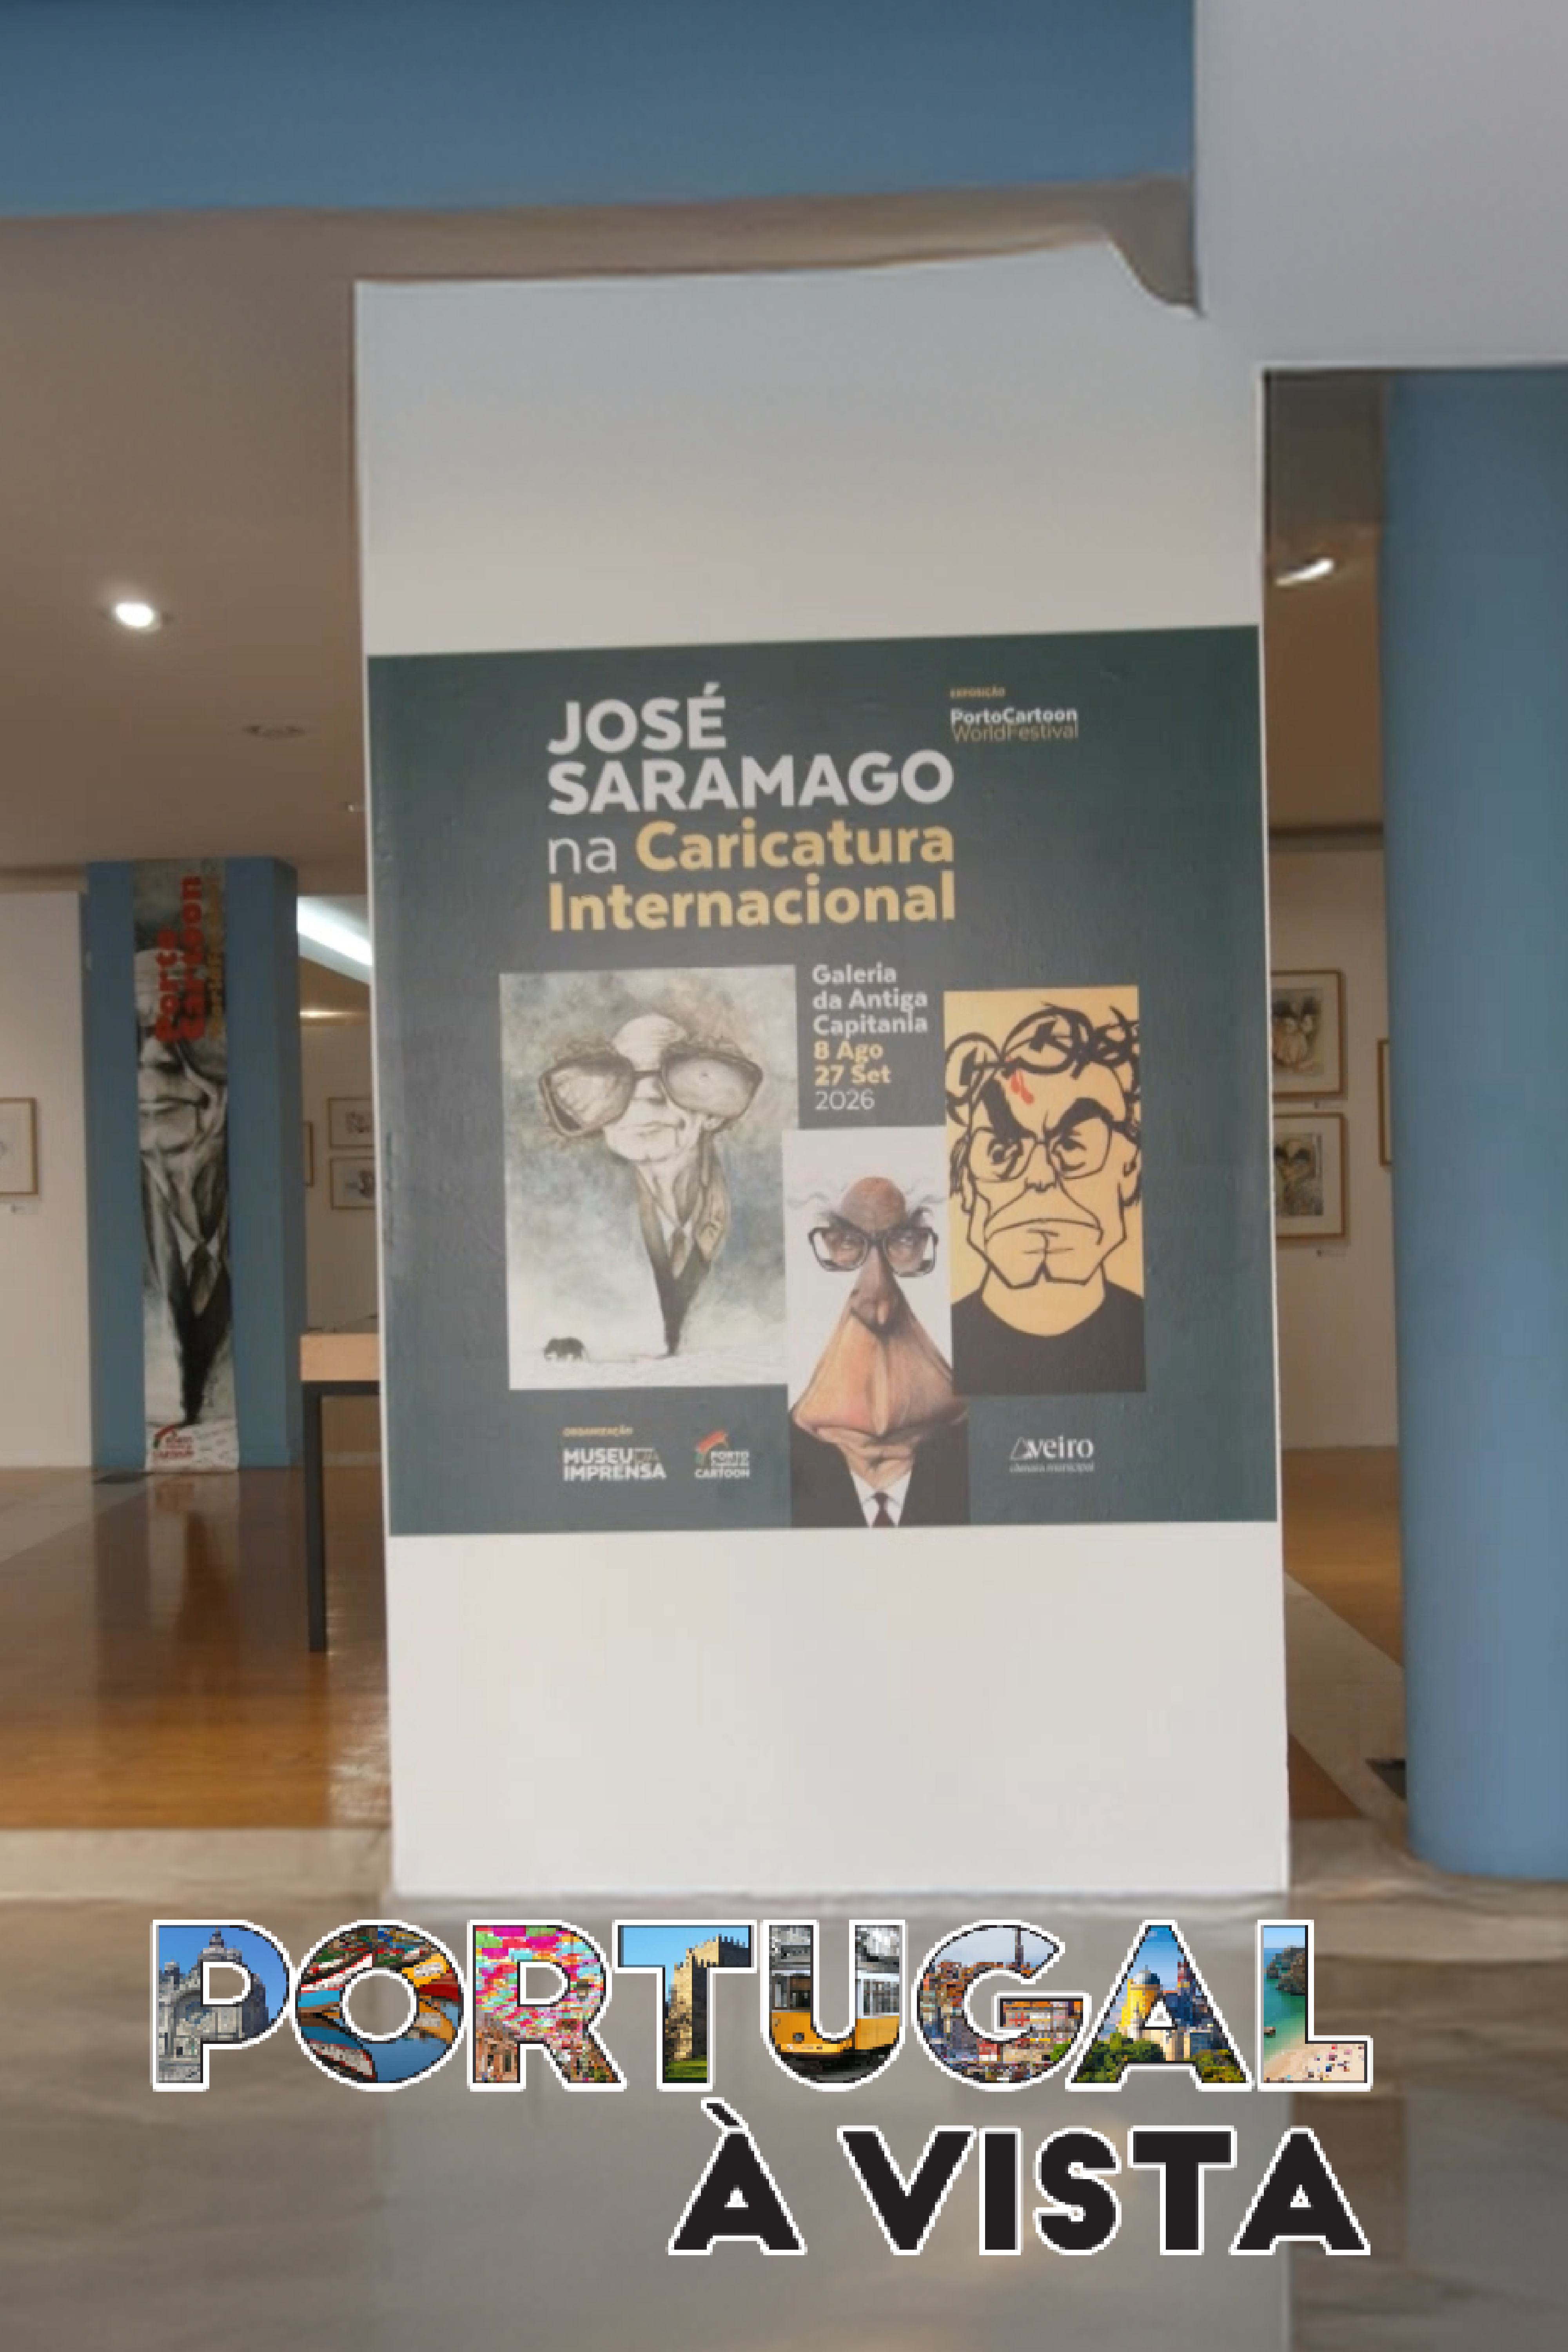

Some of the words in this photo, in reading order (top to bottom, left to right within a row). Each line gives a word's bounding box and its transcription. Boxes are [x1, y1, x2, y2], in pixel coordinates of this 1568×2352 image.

[548, 682, 726, 754] JOSÉ
[950, 707, 1078, 724] PortoCartoon
[953, 723, 1079, 743] WorldFestival
[548, 749, 954, 815] SARAMAGO
[549, 835, 617, 875] na
[636, 817, 954, 872] Caricatura
[550, 870, 955, 931] Internacional
[812, 960, 897, 985] Galeria
[812, 990, 842, 1009] da
[848, 987, 928, 1013] Antiga
[813, 1014, 928, 1039] Capitania
[814, 1040, 830, 1060] 8
[837, 1040, 884, 1063] Ago
[815, 1065, 844, 1087] 27
[850, 1064, 891, 1085] Set
[815, 1089, 875, 1111] 2026
[563, 1448, 633, 1465] MUSEU
[563, 1463, 667, 1482] IMPRENSA
[694, 1468, 750, 1480] CARTOON
